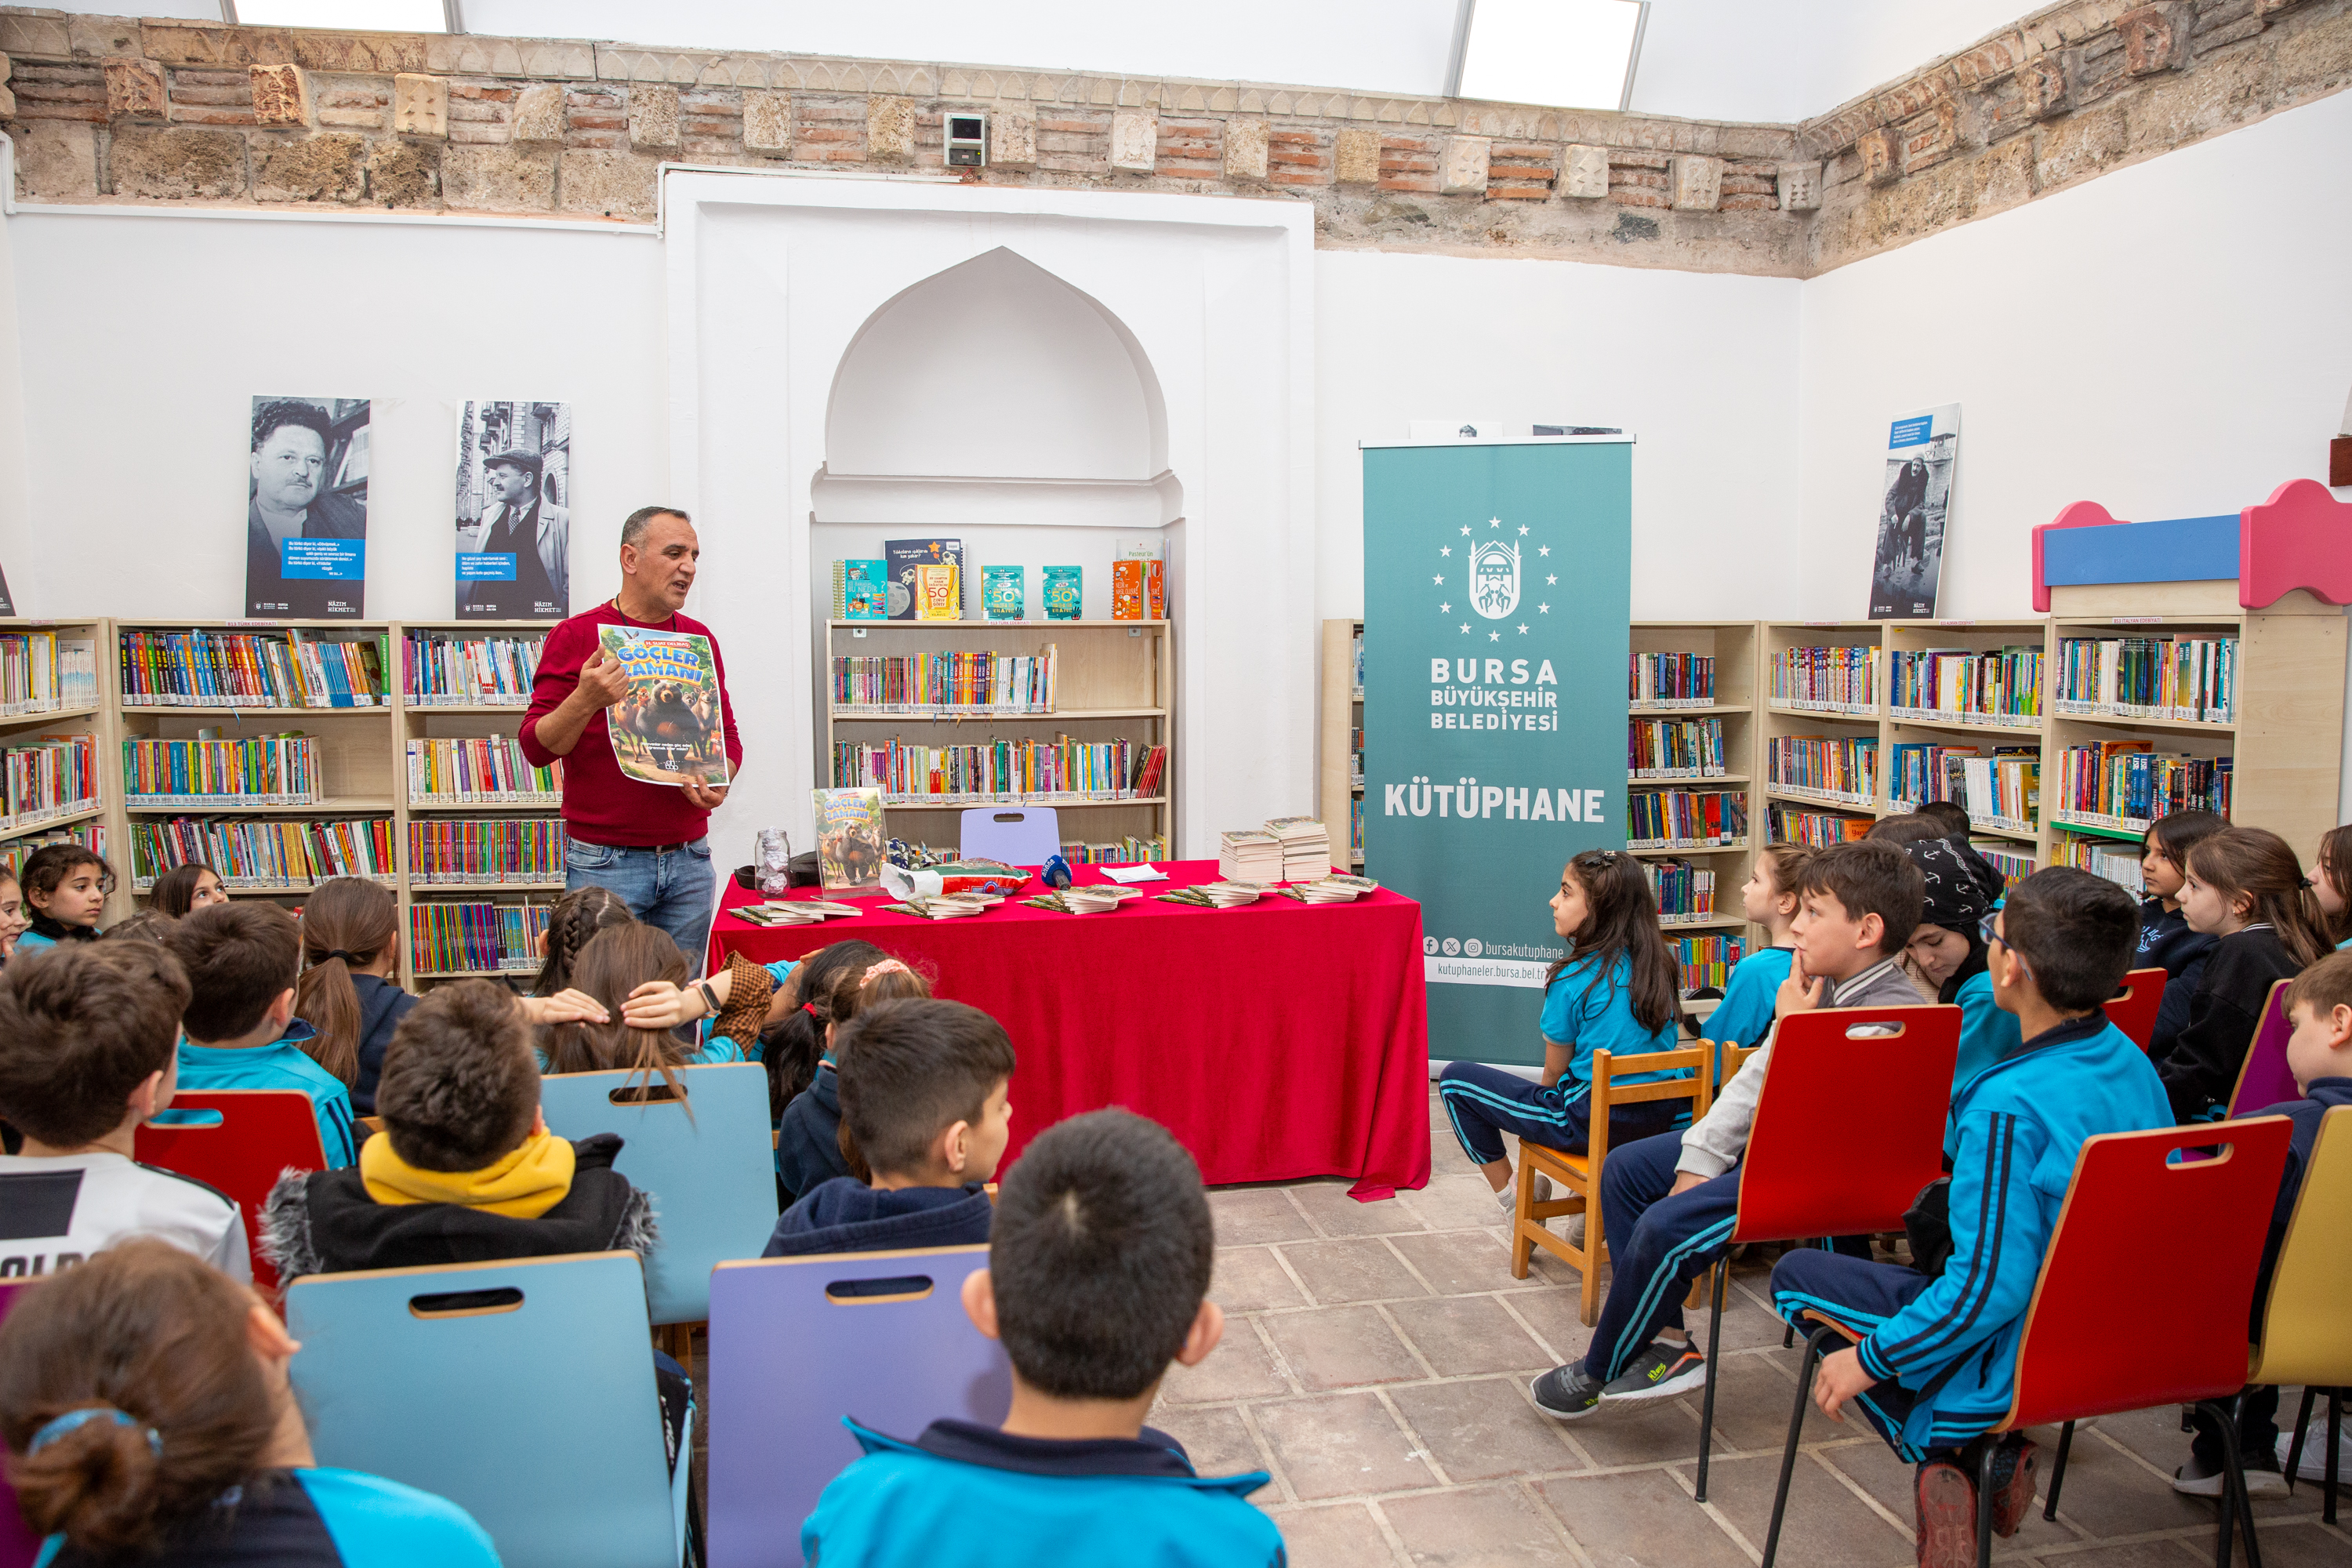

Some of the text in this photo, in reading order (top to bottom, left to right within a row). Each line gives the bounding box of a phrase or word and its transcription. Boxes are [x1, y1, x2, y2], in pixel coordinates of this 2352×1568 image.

[929, 587, 949, 597] 50
[993, 591, 1014, 602] 50
[1052, 591, 1073, 602] 50
[618, 644, 699, 666] GÖÇLER
[620, 662, 703, 682] ZAMANI
[1432, 658, 1558, 685] BURSA
[1432, 685, 1558, 710] BÜYÜKŞEHİR
[1432, 710, 1558, 731] BELEDİYESİ
[825, 798, 867, 810] GÖÇLER
[1385, 776, 1604, 823] KÜTÜPHANE
[825, 809, 869, 822] ZAMANI
[1486, 942, 1564, 960] bursakutuphane
[1438, 963, 1544, 980] kutuphaneler.bursa.bel.tr
